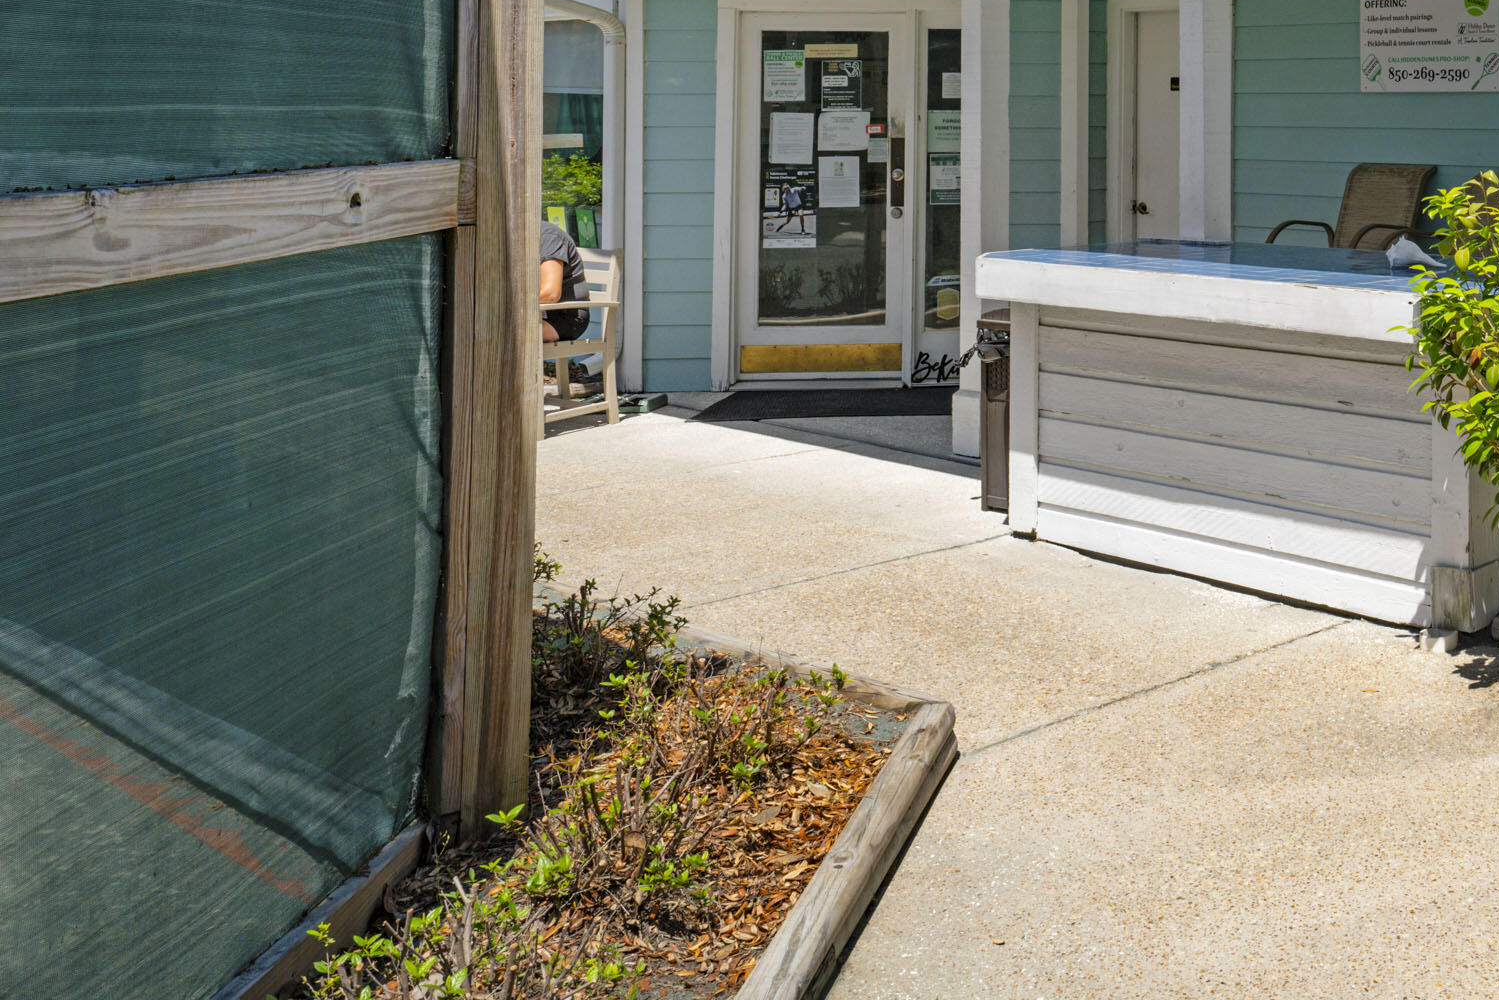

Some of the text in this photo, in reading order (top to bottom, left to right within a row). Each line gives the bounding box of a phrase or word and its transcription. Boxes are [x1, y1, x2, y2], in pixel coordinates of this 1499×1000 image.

[1364, 0, 1407, 9] OFFERING:
[1410, 14, 1433, 22] pairings
[1389, 26, 1416, 34] individual
[1367, 39, 1392, 47] Pickleball
[1388, 66, 1470, 82] 850-269-2590
